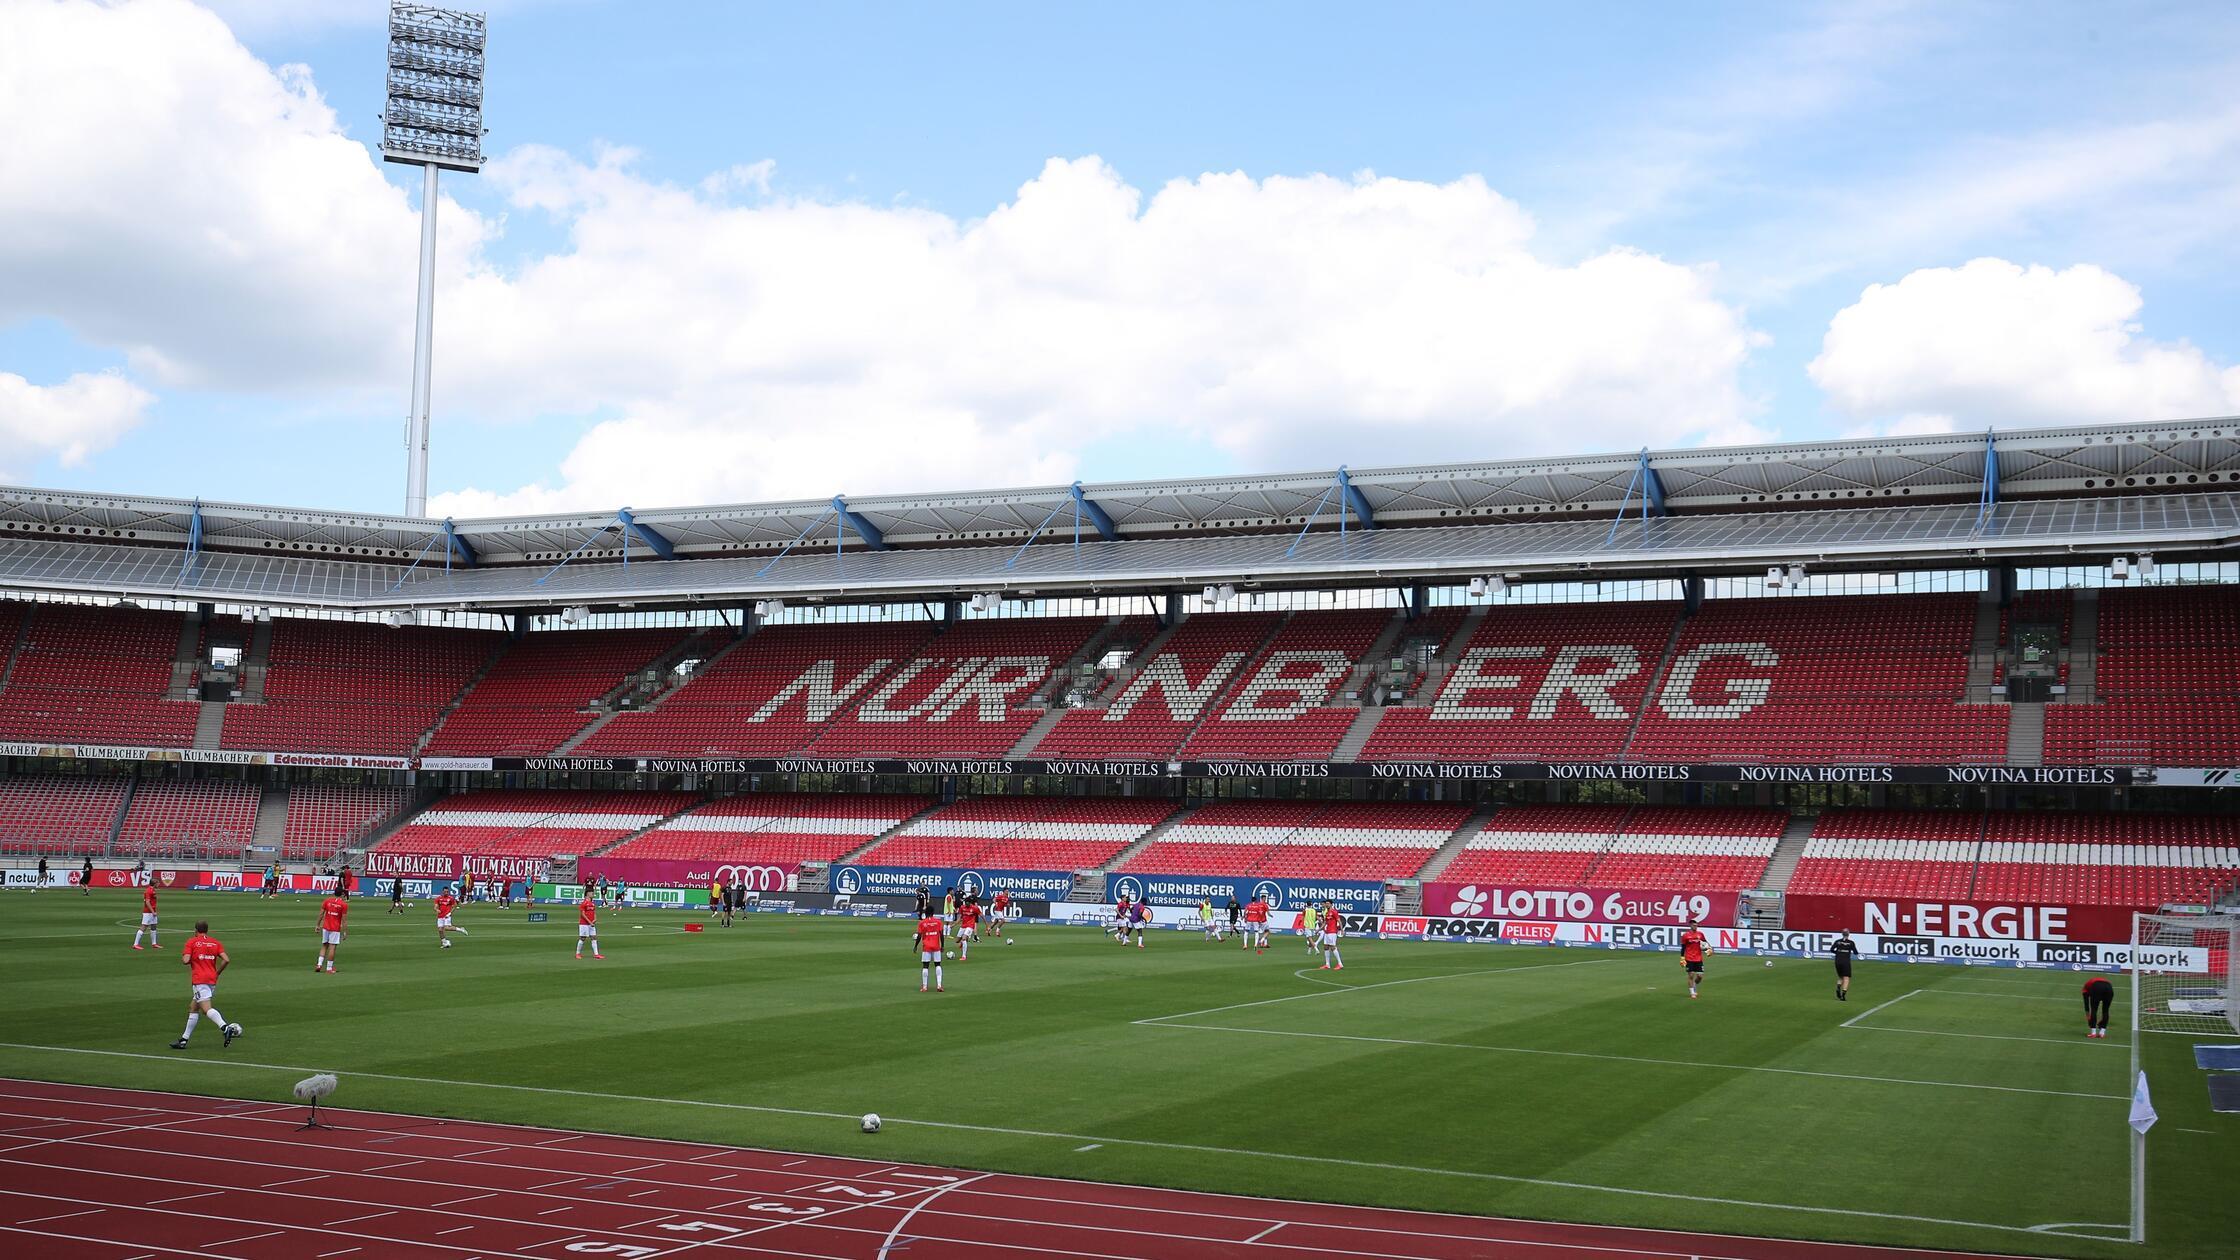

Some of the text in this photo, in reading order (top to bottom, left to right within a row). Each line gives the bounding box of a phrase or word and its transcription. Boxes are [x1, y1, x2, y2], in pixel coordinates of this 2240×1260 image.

[77, 746, 145, 759] KULMBACHER
[183, 750, 249, 762] KULMBACHER
[274, 754, 404, 769] Edelmetalle Hanauer
[425, 761, 489, 770] www.gold-hanauer.de
[525, 759, 613, 771] NOVINA HOTELS
[652, 761, 746, 773] NOVINA HOTELS
[776, 761, 874, 773] NOVINA HOTELS
[907, 762, 1012, 774] NOVINA HOTELS
[1046, 762, 1158, 775] NOVINA HOTELS
[1208, 763, 1329, 777] NOVINA HOTELS
[1372, 764, 1501, 778] NOVINA HOTELS
[1549, 765, 1689, 779] NOVINA HOTELS
[1739, 766, 1893, 782] NOVINA HOTELS
[1947, 767, 2114, 783] NOVINA HOTELS
[367, 853, 452, 873] KULMBACHER
[9, 872, 55, 883] netwk
[687, 871, 710, 880] Audi
[867, 873, 942, 885] NÜRNBERGER
[989, 877, 1069, 889] NÜRNBERGER
[1148, 882, 1234, 896] NÜRNBERGER
[989, 890, 1045, 899] VERICHERUNG
[1289, 887, 1379, 901] NÜRNBERGER
[990, 902, 1022, 917] Cub
[1289, 902, 1353, 910] VERCHRUNG
[1493, 890, 1593, 919] LOTTO
[1385, 920, 1420, 933] HEIZÖL
[1427, 919, 1500, 937] ROSA
[1506, 926, 1551, 938] PELLETS
[1883, 939, 2020, 959] noris network
[2043, 947, 2091, 962] noris
[816, 1185, 896, 1197] 2
[748, 1203, 825, 1214] 3
[656, 1221, 744, 1232] 4
[565, 1242, 660, 1257] 5
